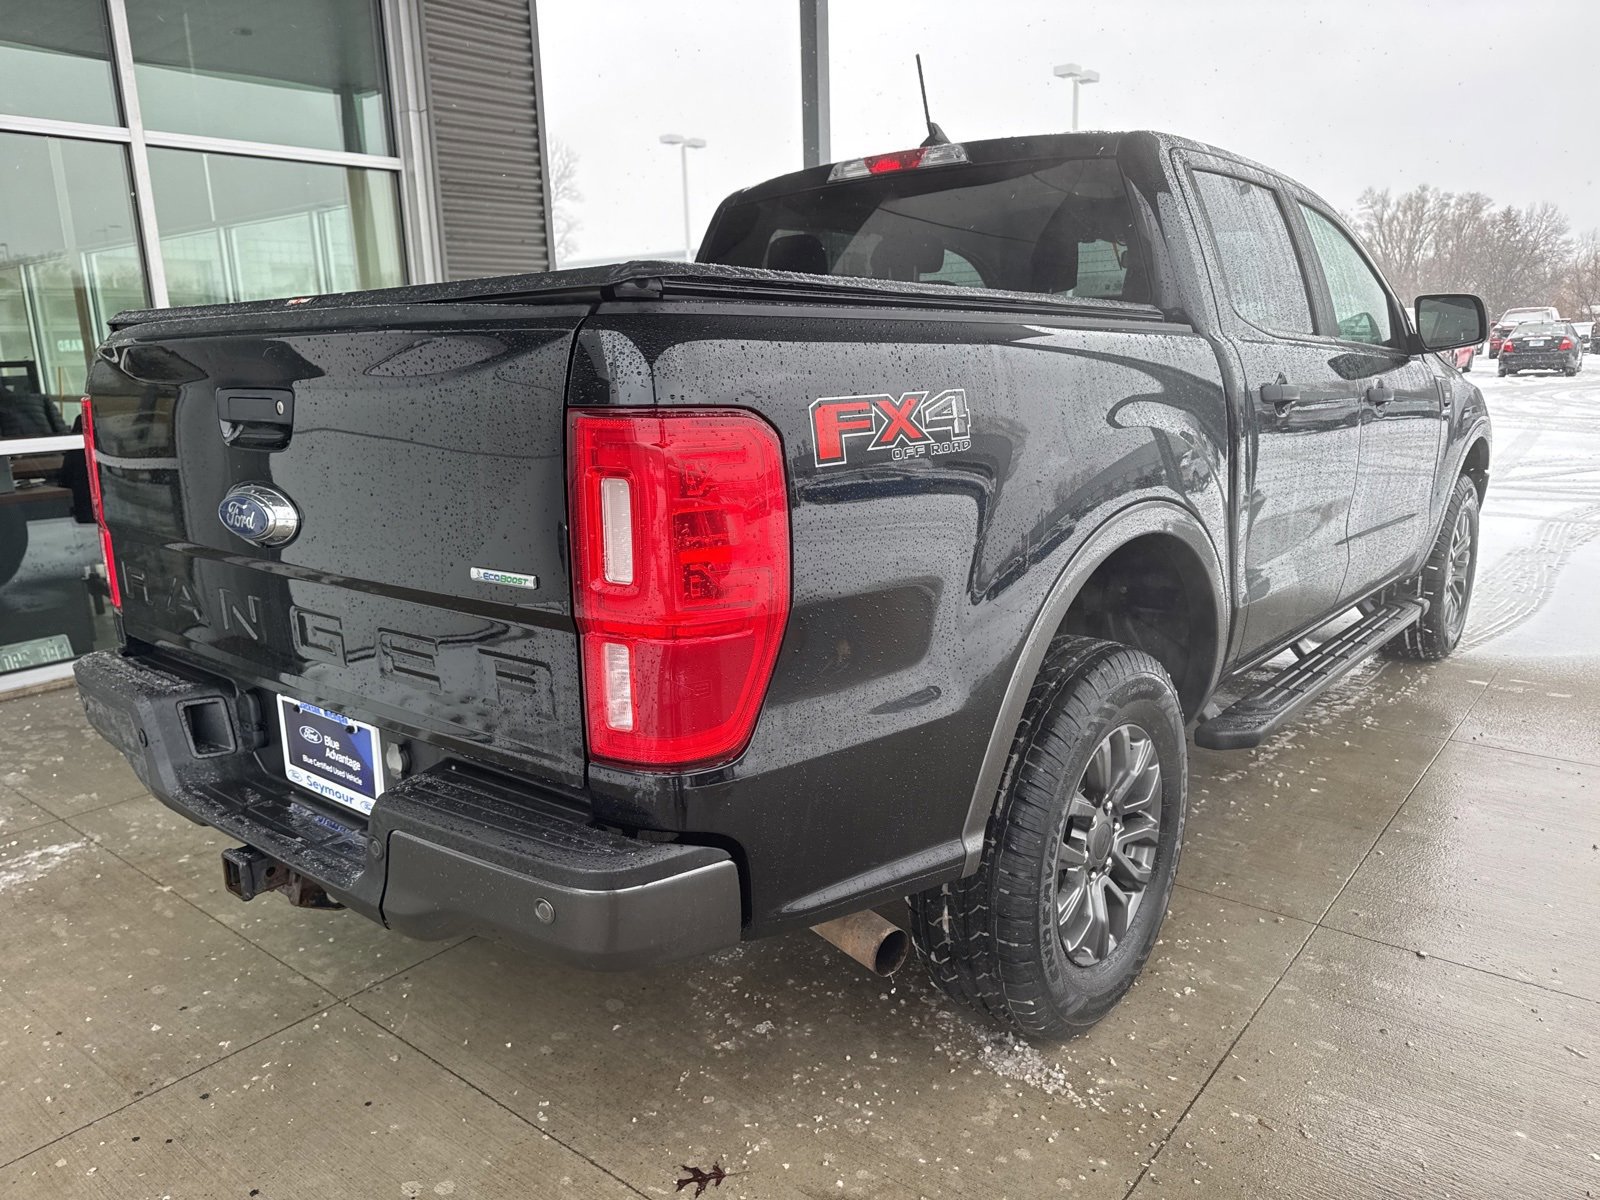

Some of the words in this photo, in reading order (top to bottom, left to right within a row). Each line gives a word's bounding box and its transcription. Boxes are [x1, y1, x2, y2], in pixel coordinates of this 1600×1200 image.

[809, 388, 971, 468] FX4
[891, 444, 925, 461] OFF
[930, 439, 972, 456] ROAD
[226, 501, 256, 530] Ford
[121, 560, 558, 721] RANGER
[324, 735, 340, 750] Blue
[325, 748, 361, 771] Advantage
[306, 775, 355, 805] Seymour
